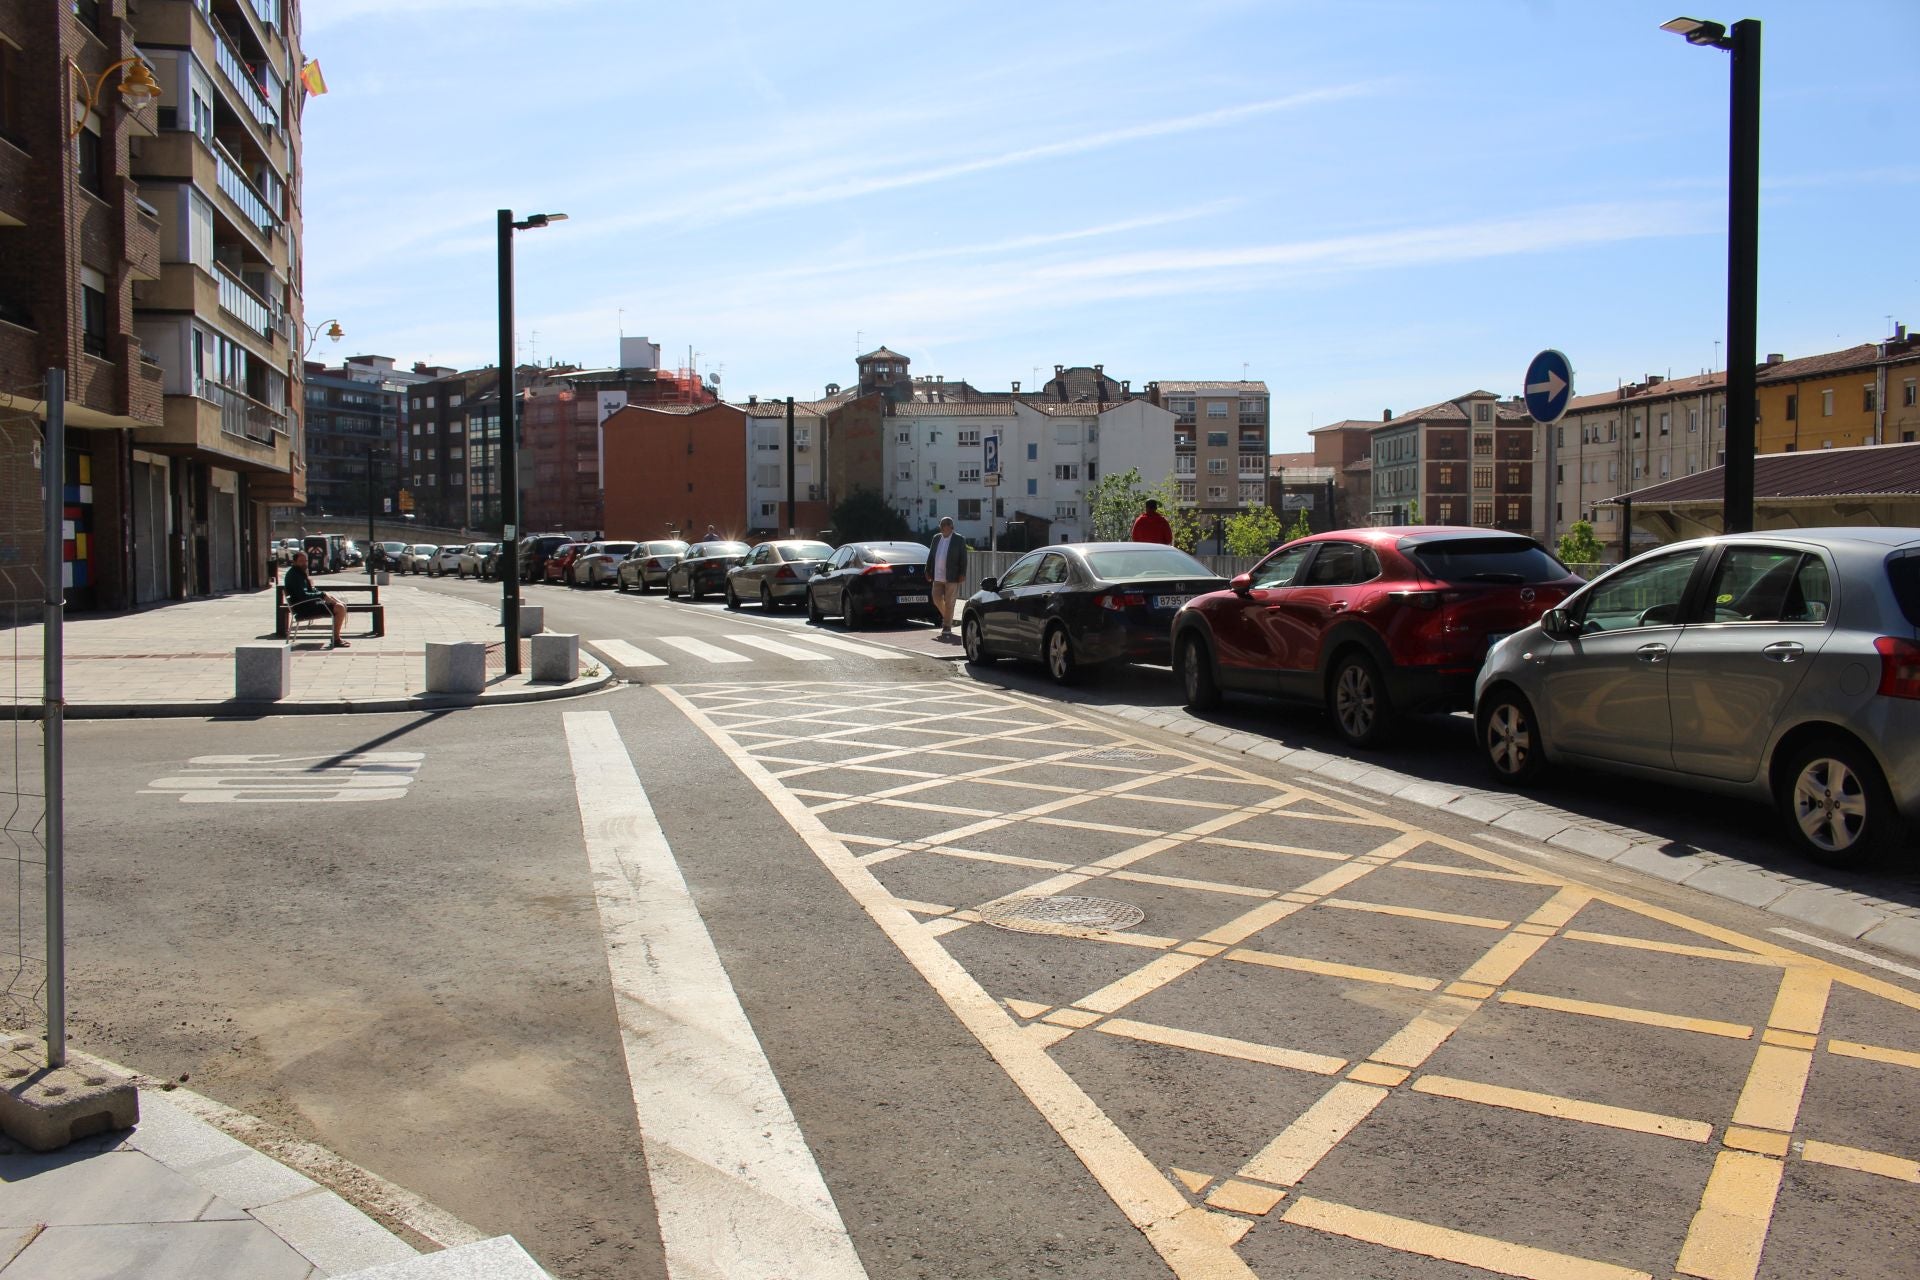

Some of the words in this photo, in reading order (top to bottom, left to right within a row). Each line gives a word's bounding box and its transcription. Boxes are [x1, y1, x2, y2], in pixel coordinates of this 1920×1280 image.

[986, 440, 996, 468] P
[1160, 596, 1182, 606] 8795
[135, 752, 426, 802] STOP
